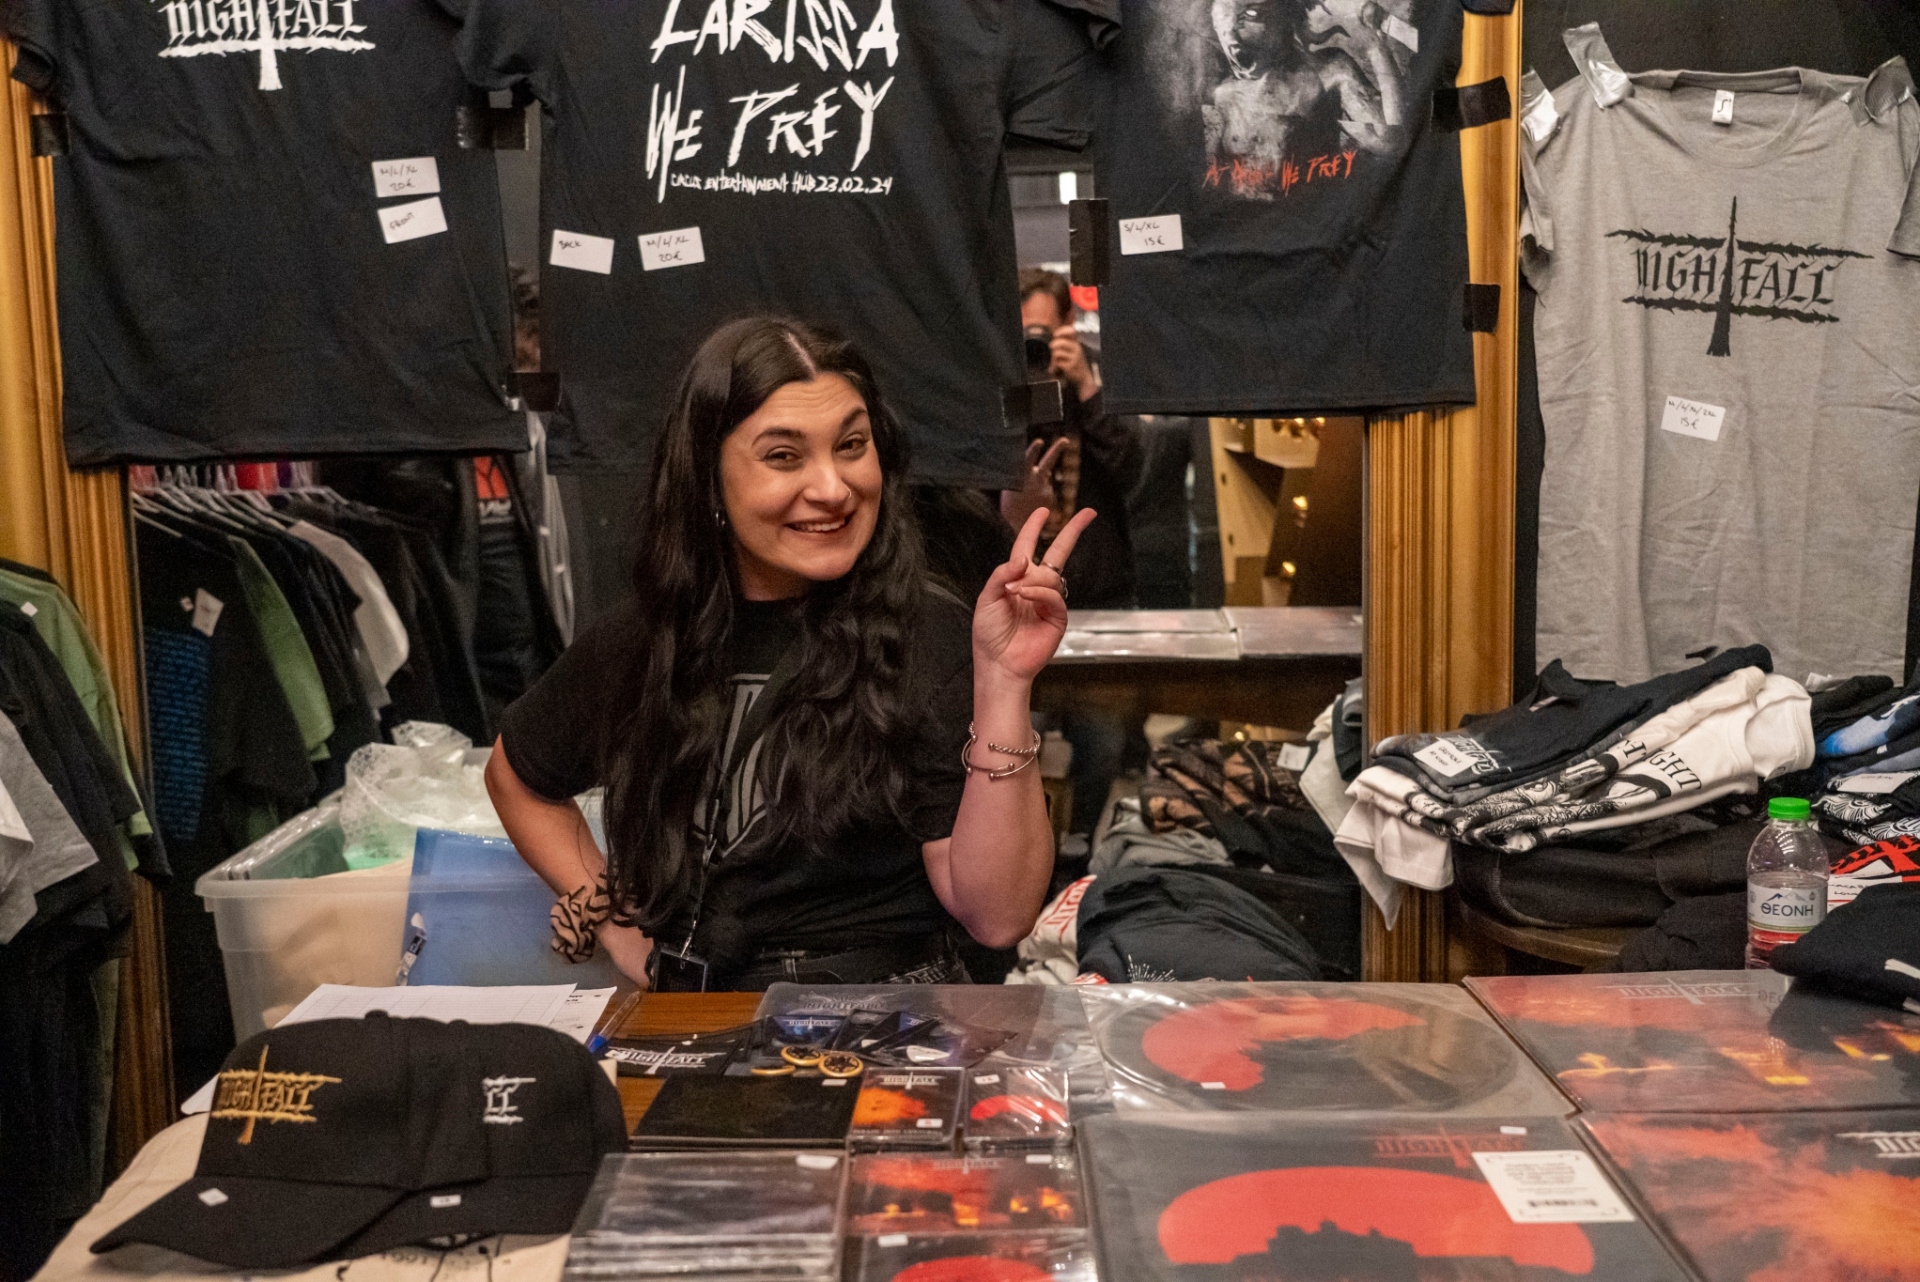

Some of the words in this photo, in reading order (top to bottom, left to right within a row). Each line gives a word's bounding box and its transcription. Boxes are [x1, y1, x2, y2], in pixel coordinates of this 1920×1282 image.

[158, 0, 376, 60] NIGHTFALL
[650, 0, 900, 72] LARISSA
[645, 65, 704, 203] WE
[727, 76, 895, 172] PREY
[1306, 149, 1357, 184] PREY
[814, 175, 893, 195] 23.02.24
[1123, 222, 1160, 234] S/L/XL
[658, 250, 683, 263] 20€
[1604, 226, 1875, 325] NIGHTFALL
[1760, 901, 1814, 917] ΘΕΟΝΗ
